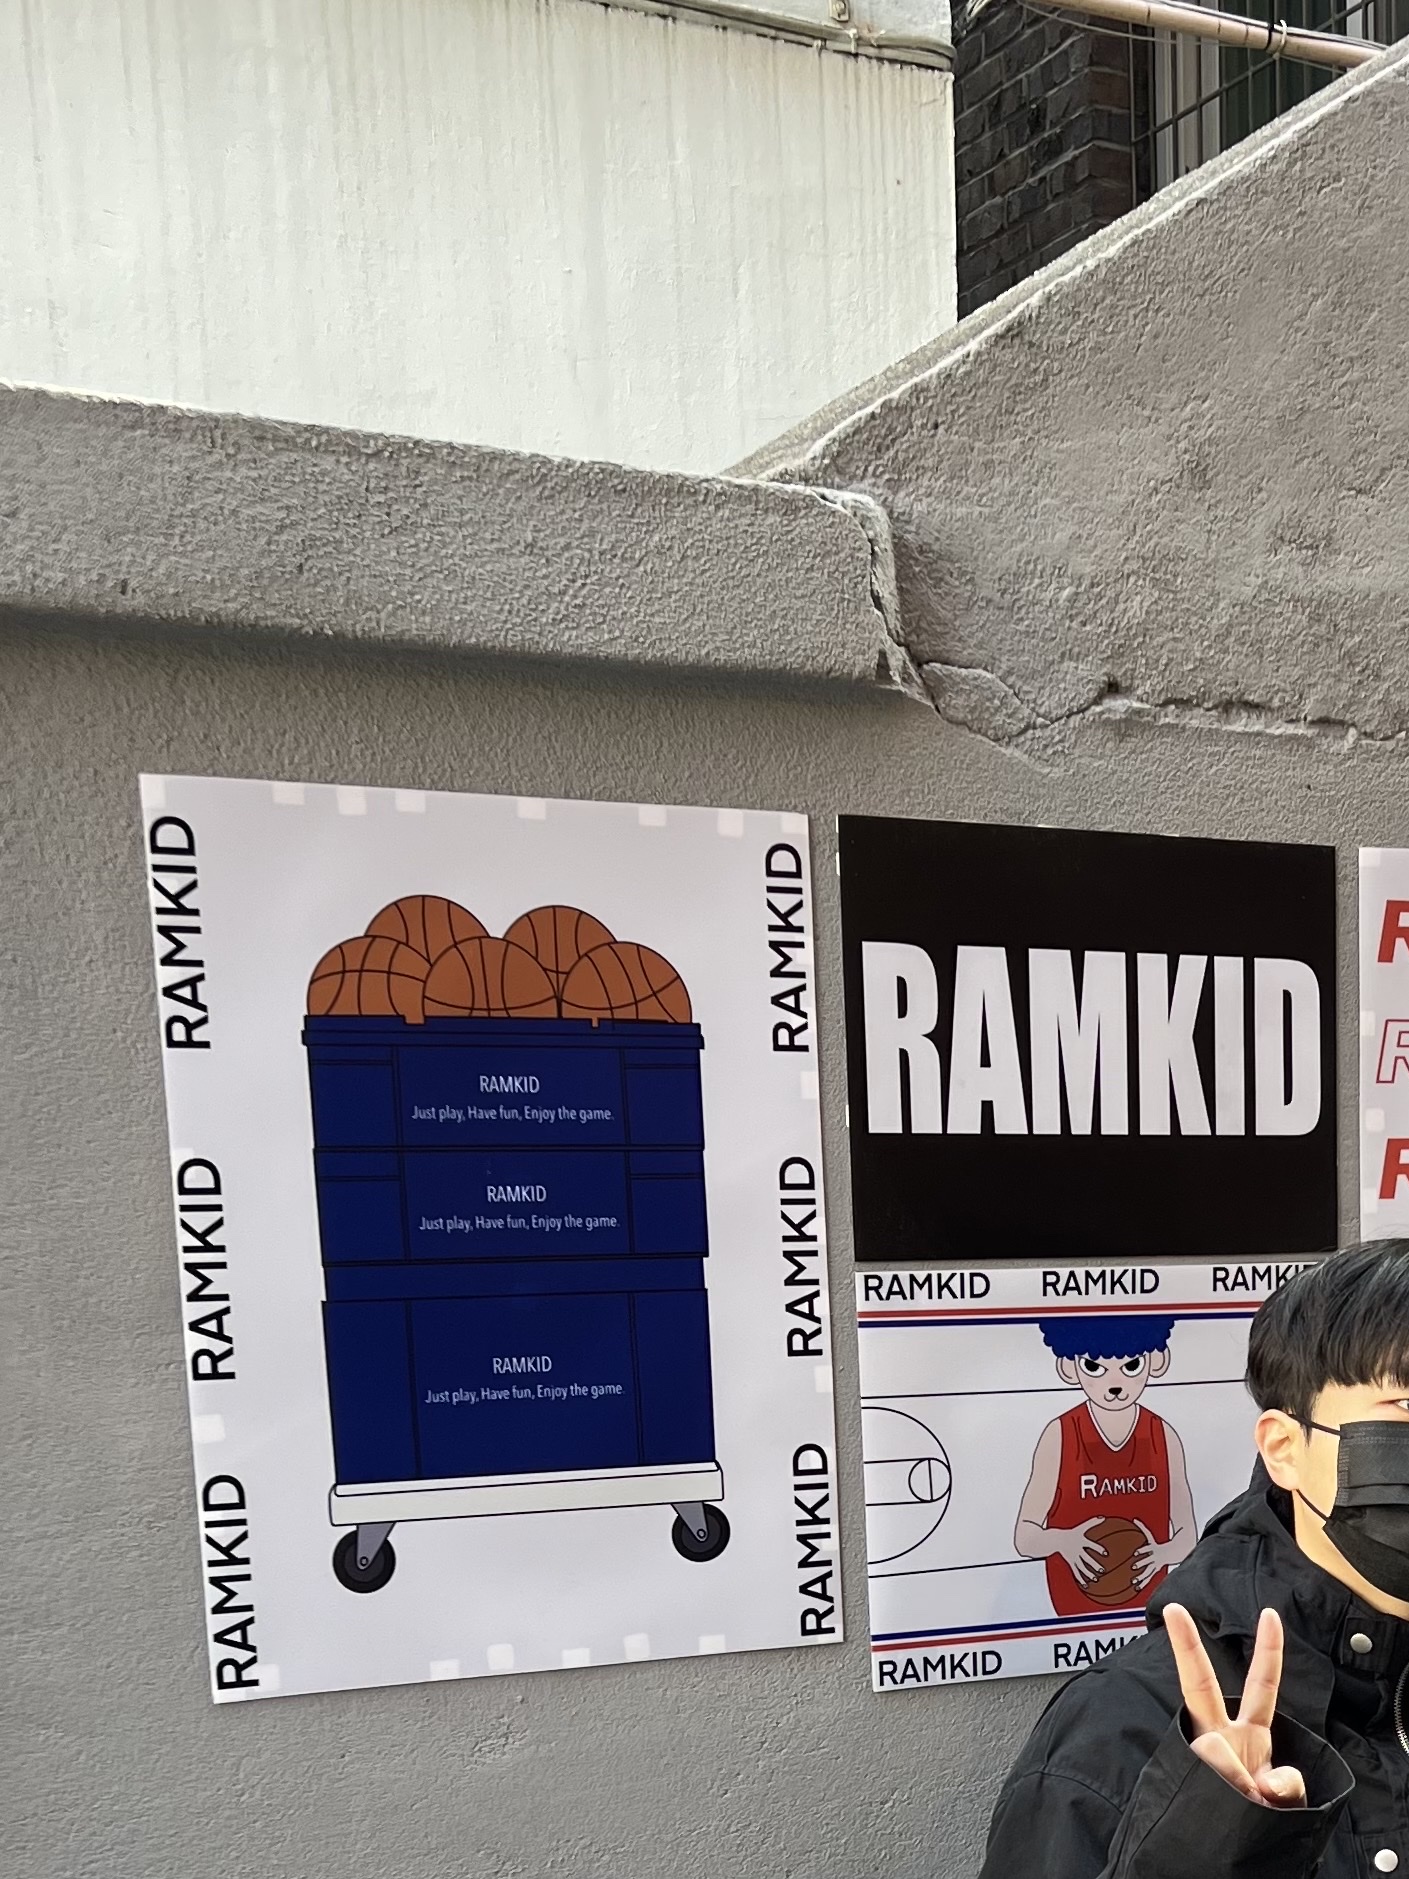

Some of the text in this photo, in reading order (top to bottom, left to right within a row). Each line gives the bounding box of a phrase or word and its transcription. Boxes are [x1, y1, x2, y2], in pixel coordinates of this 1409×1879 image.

[150, 815, 211, 1049] RAMKID
[765, 843, 809, 1053] RAMKID
[861, 940, 1322, 1138] RAMKID
[479, 1075, 541, 1094] RAMKID
[411, 1105, 436, 1120] Just
[467, 1106, 497, 1120] Have
[524, 1106, 556, 1123] Enjoy
[557, 1105, 577, 1120] the
[486, 1185, 547, 1203] RAMKID
[419, 1216, 444, 1230] Just
[475, 1215, 505, 1229] Have
[531, 1214, 562, 1232] Enjoy
[564, 1213, 583, 1228] the
[177, 1157, 236, 1381] RAMKID
[779, 1156, 823, 1357] RAMKID
[863, 1265, 1317, 1302] RAMKID RAMKID RAMK
[492, 1356, 552, 1374] RAMKID
[425, 1389, 450, 1403] Just
[480, 1387, 510, 1400] Have
[537, 1384, 568, 1401] Enjoy
[570, 1383, 589, 1396] the
[1080, 1474, 1158, 1499] RAMKID
[793, 1443, 836, 1637] RAMKID
[202, 1474, 260, 1691] RAMKID
[878, 1635, 1138, 1687] RAMKID RAM
